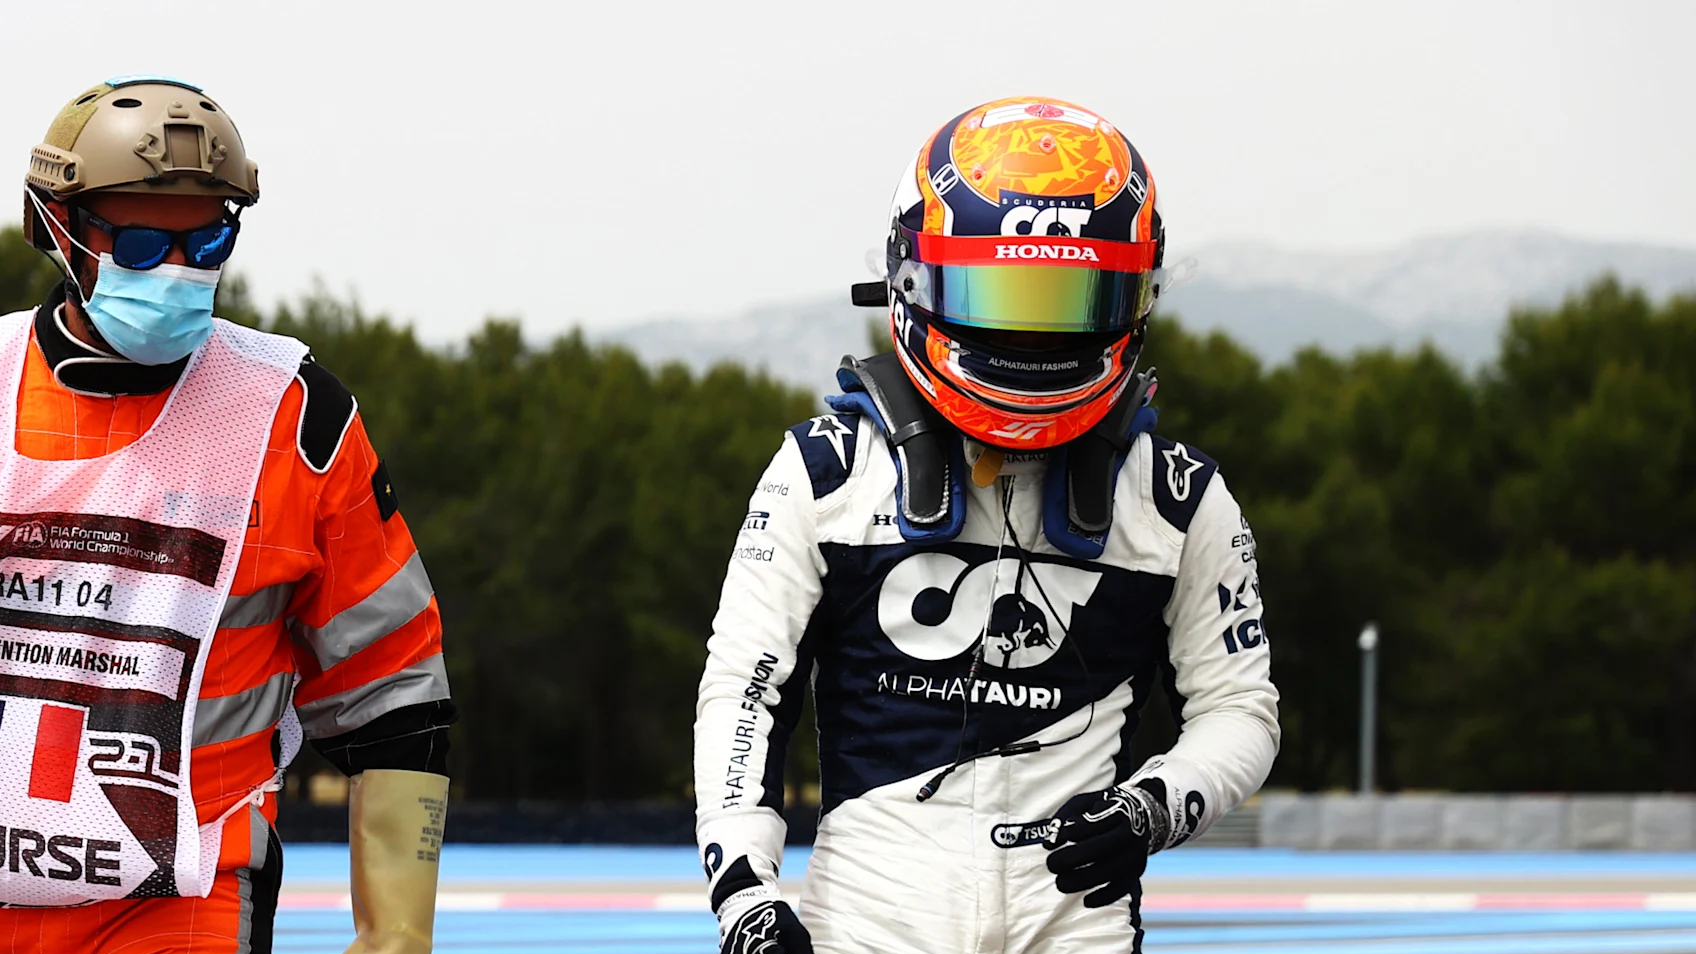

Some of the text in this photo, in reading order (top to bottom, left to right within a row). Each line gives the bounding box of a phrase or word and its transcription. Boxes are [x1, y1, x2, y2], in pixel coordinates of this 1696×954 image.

[1002, 198, 1086, 208] SCUDERIA
[994, 244, 1100, 262] HONDA
[50, 526, 69, 537] FIA
[70, 527, 122, 542] Formula
[49, 538, 169, 565] World Championship
[77, 580, 114, 611] 04
[55, 646, 141, 677] MARSHAL
[877, 672, 1062, 710] ALPHATAURI
